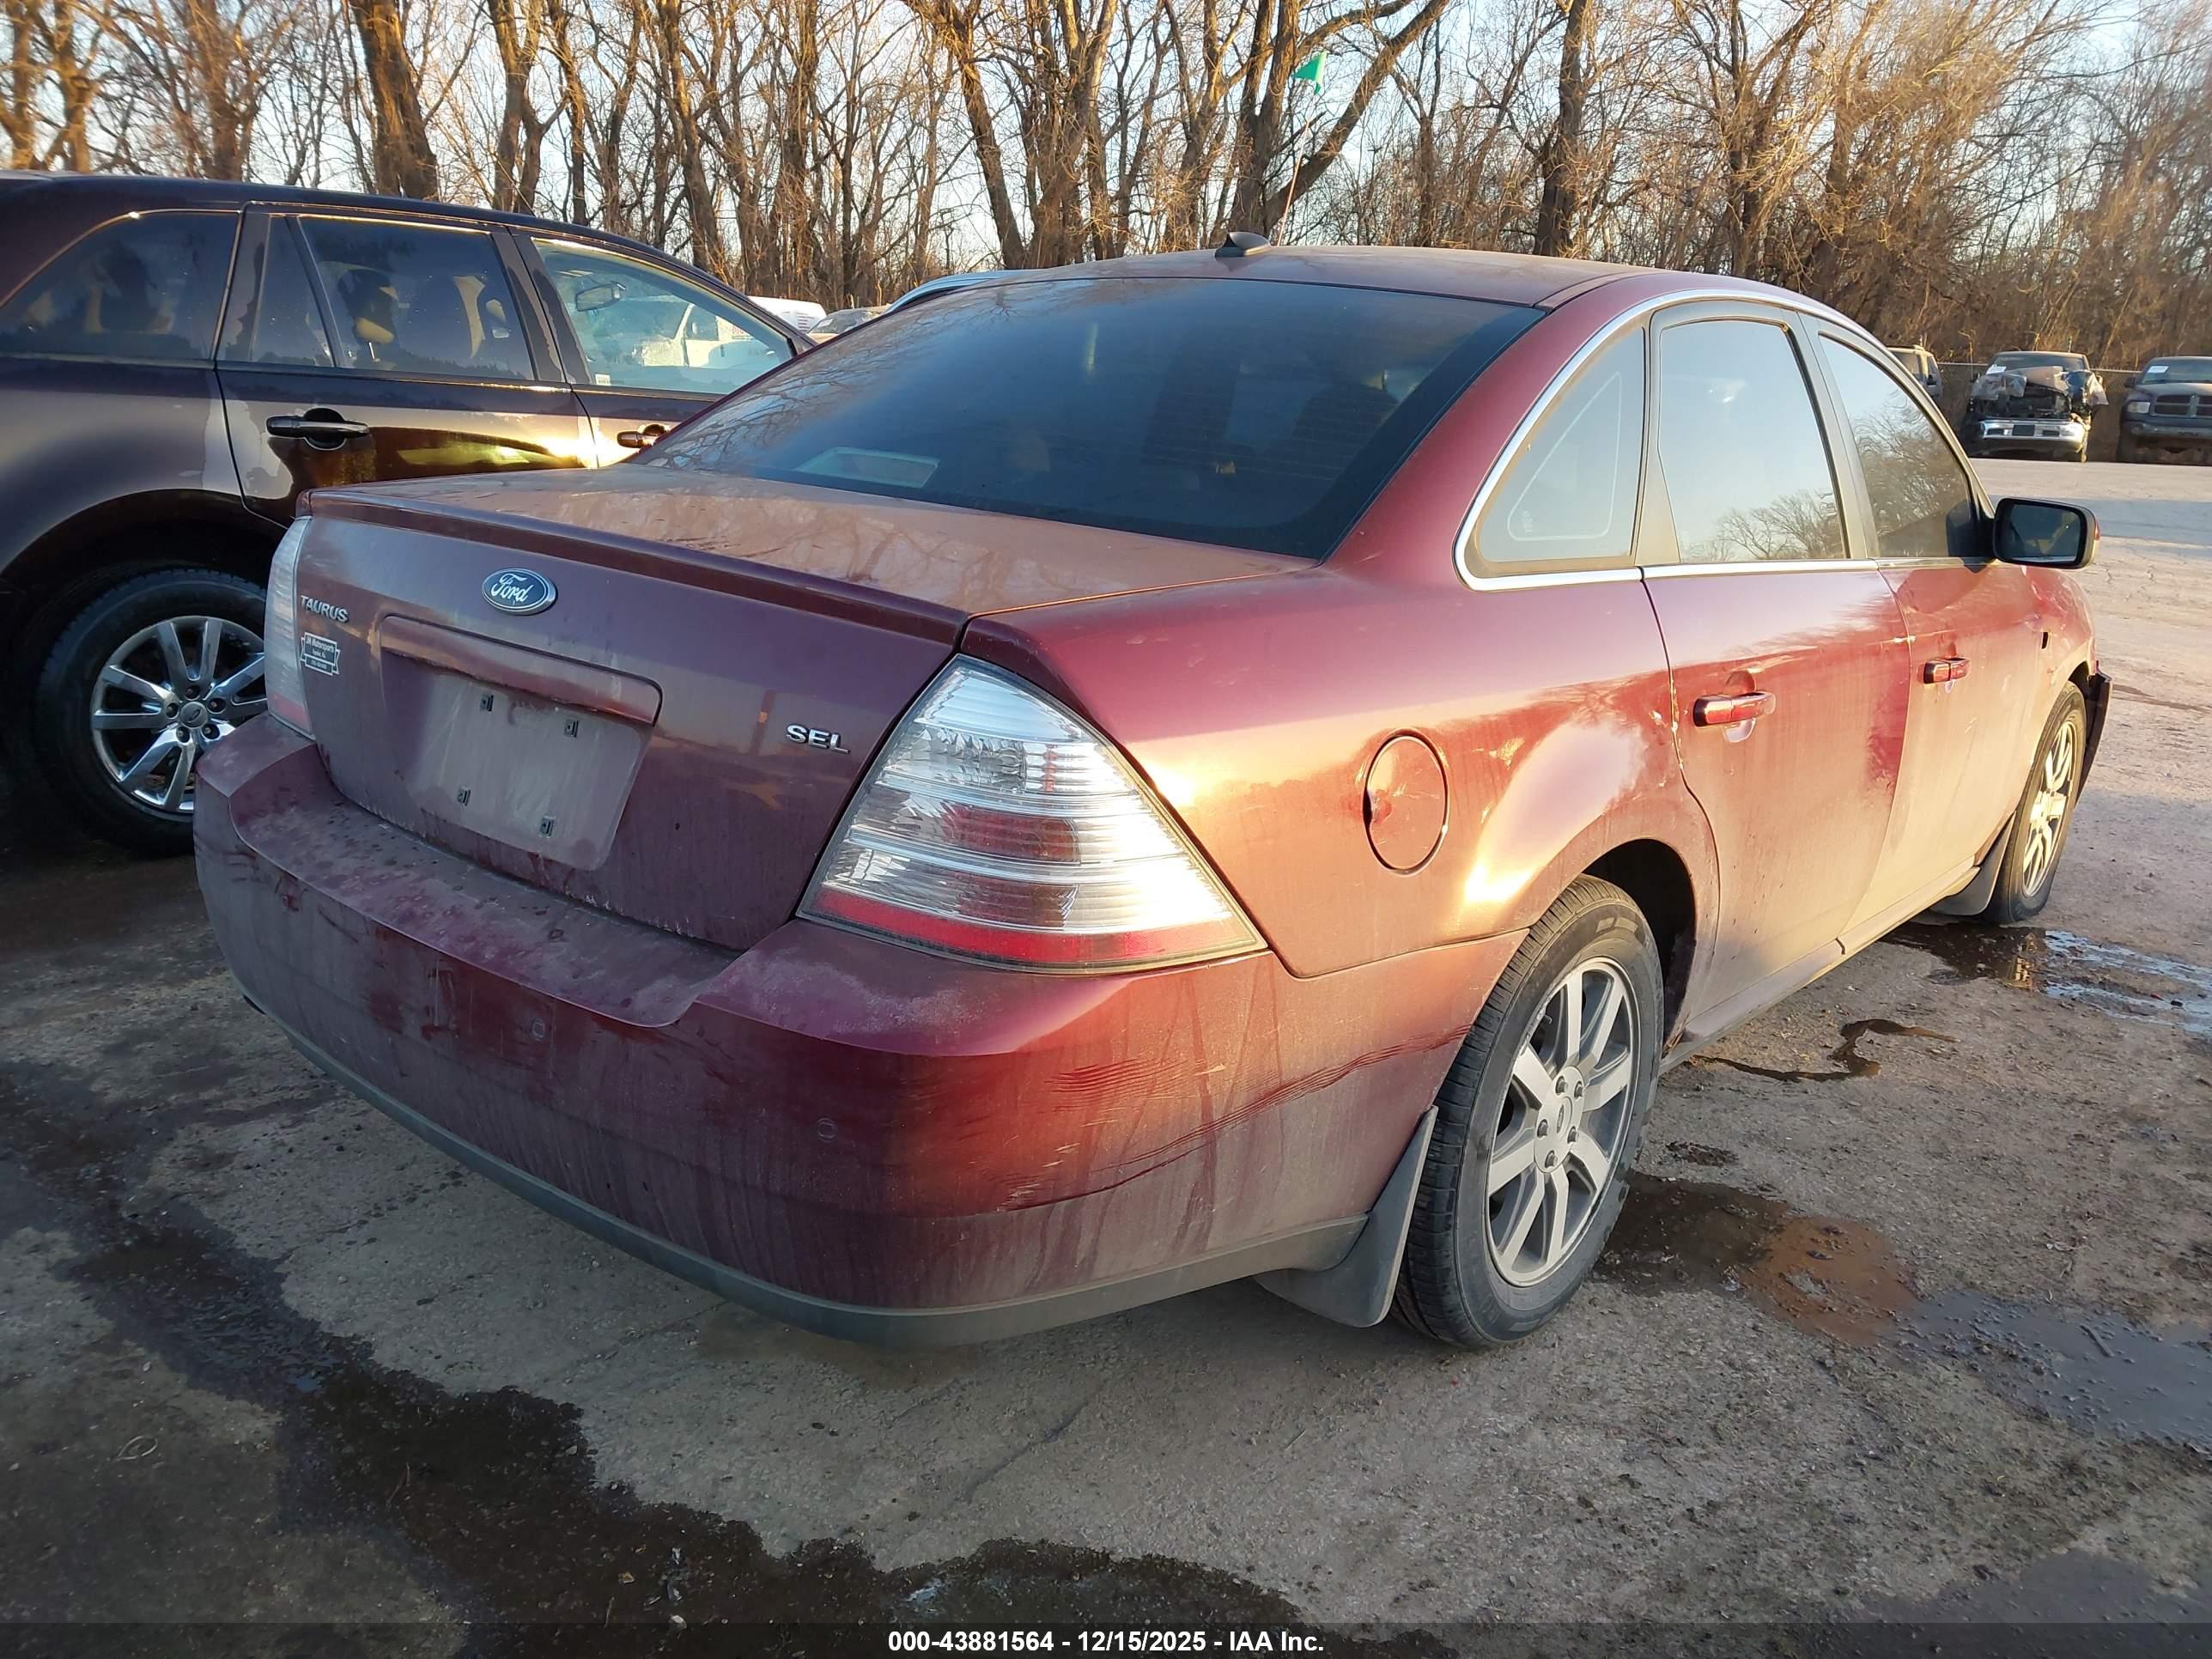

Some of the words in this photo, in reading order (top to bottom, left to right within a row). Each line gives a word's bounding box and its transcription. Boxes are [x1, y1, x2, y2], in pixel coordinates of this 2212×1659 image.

[491, 573, 534, 602] Ford
[301, 594, 349, 623] TAURUS
[786, 724, 850, 754] SEL
